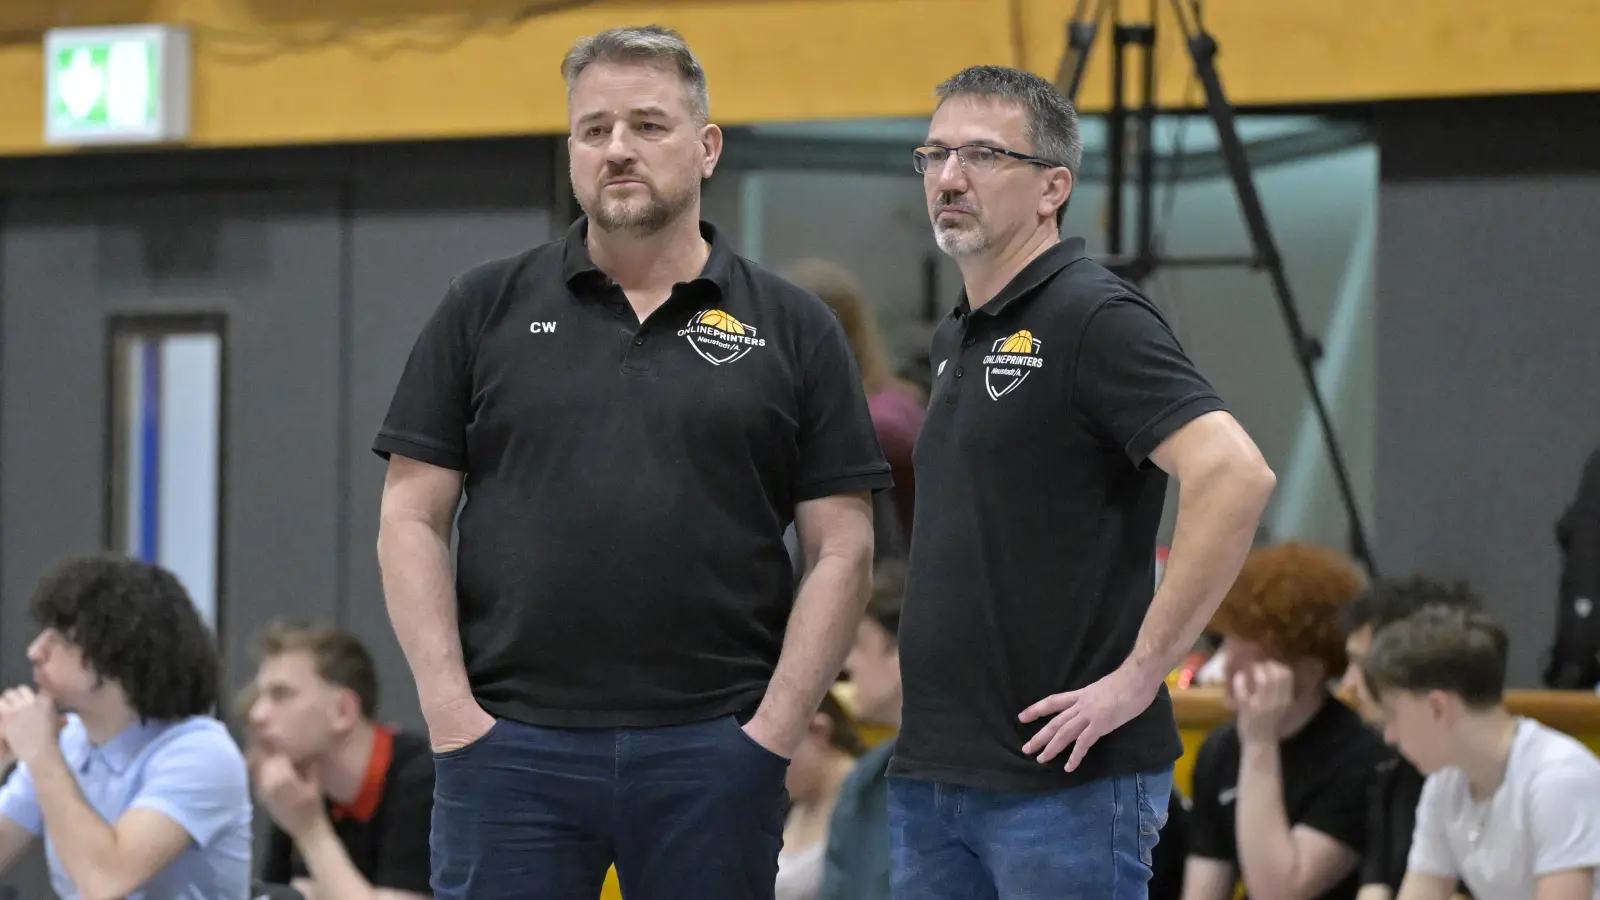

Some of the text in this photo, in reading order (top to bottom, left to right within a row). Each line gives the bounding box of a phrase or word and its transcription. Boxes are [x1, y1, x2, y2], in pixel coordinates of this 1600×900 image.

[530, 321, 556, 333] CW
[677, 326, 766, 347] ONLINEPRINTERS
[983, 354, 1043, 368] ONLINEPRINTERS
